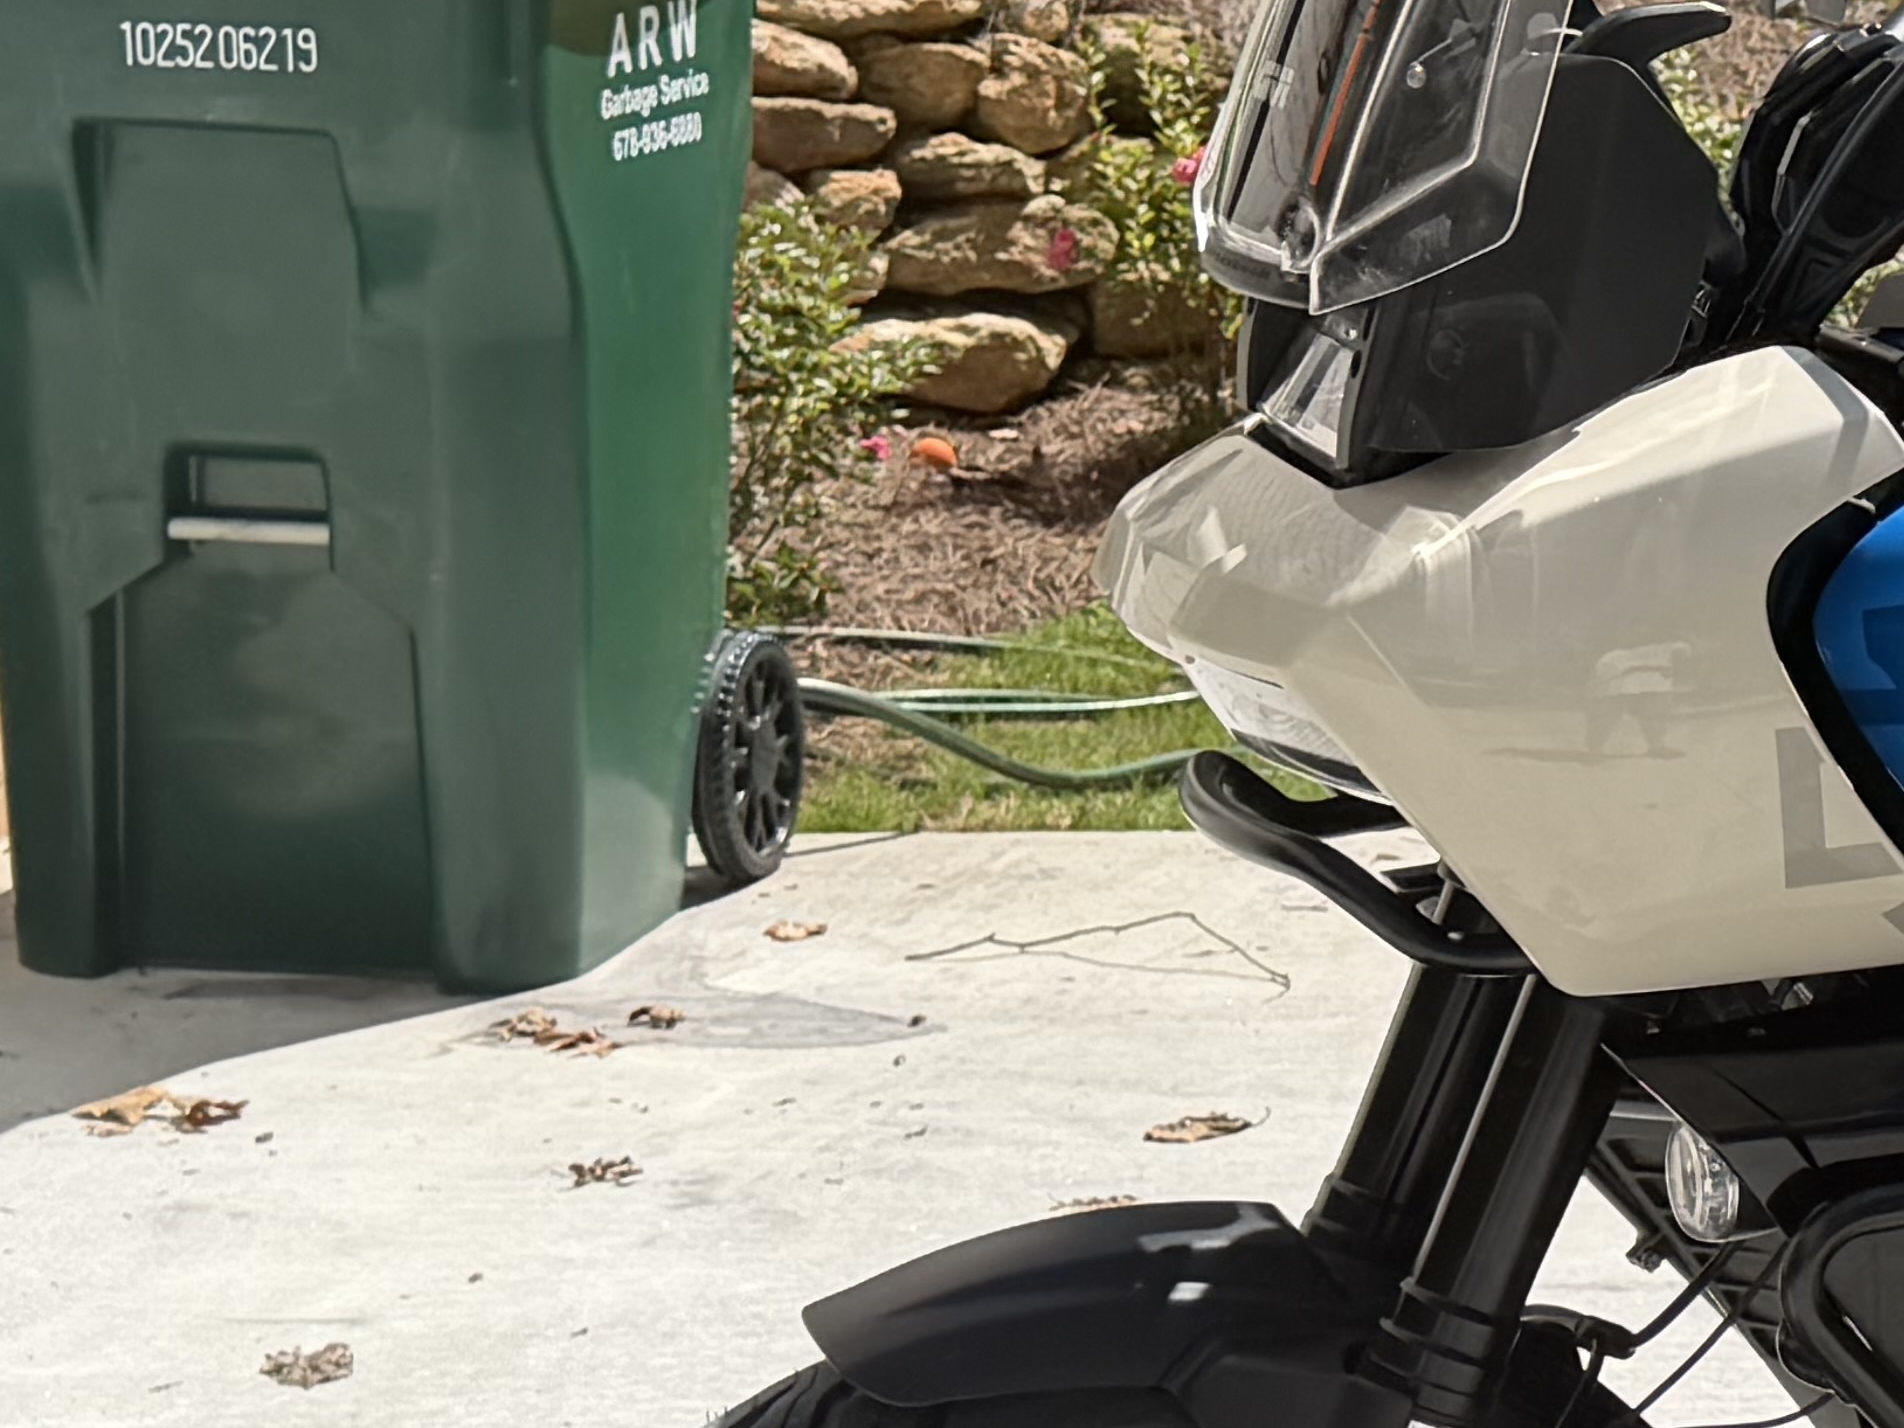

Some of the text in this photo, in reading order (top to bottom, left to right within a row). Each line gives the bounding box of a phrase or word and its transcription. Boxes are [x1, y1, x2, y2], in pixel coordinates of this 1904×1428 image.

[119, 21, 318, 72] 1025206219
[601, 68, 710, 120] Garbage Service
